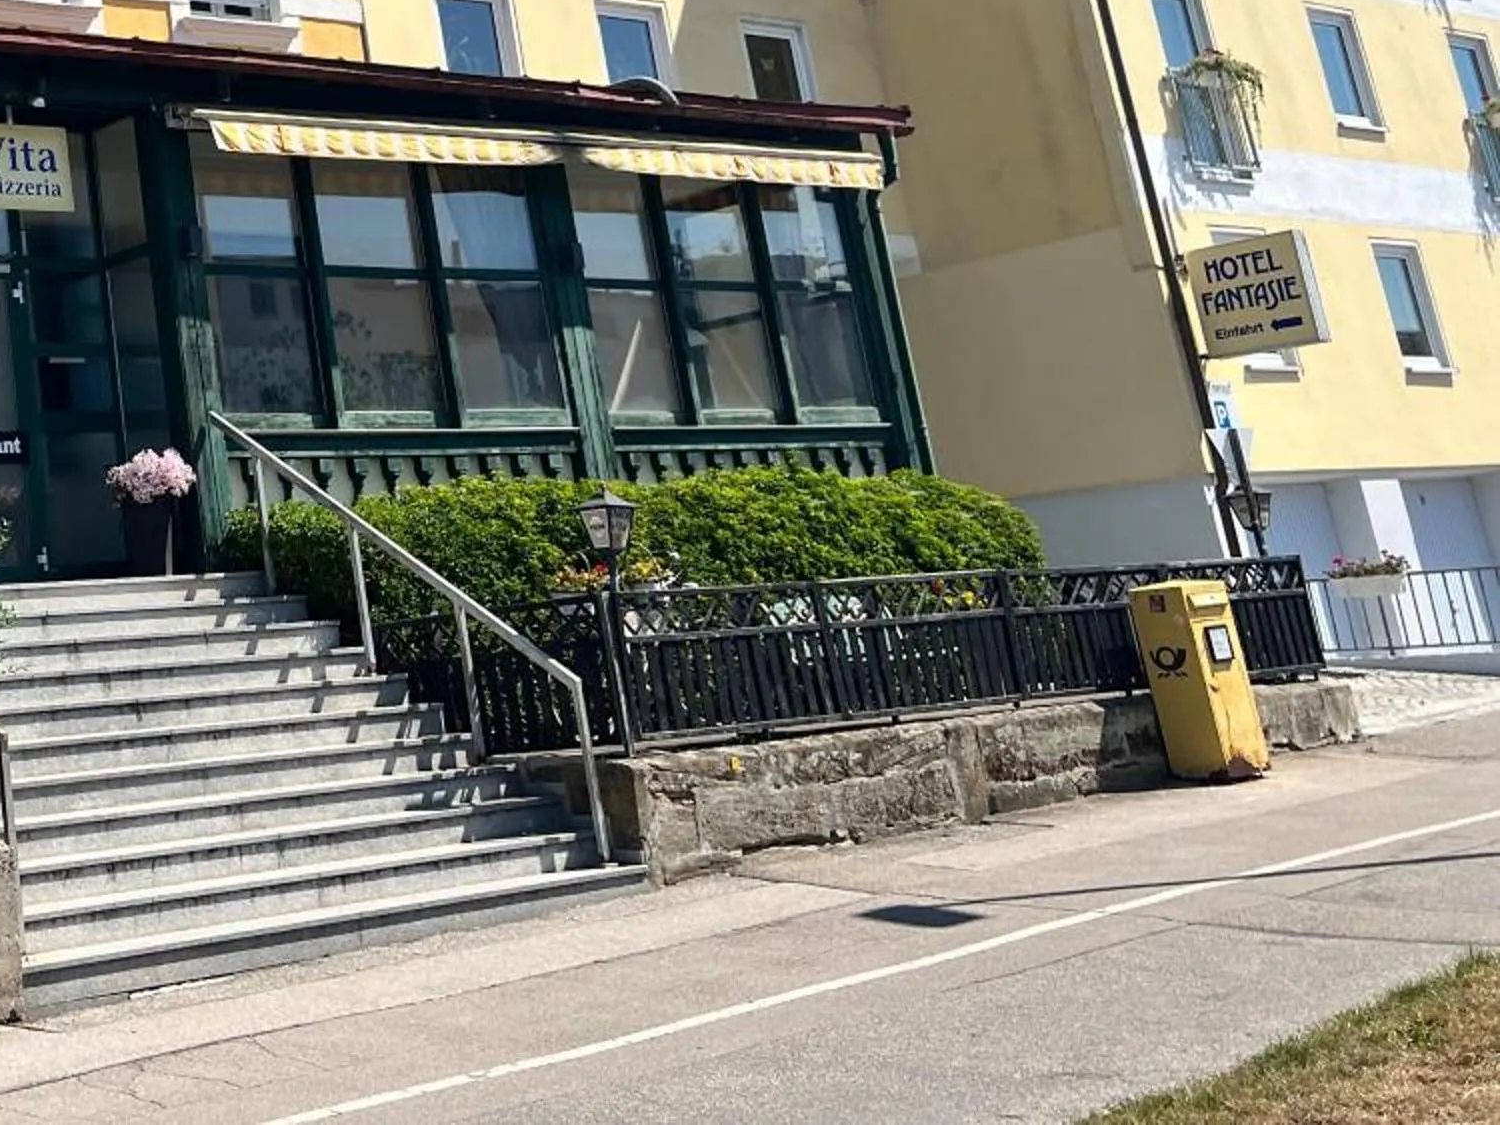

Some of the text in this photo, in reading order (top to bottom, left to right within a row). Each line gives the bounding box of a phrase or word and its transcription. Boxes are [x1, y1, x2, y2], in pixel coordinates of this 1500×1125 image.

[1203, 248, 1283, 284] HOTEL
[1201, 276, 1301, 316] FANTASIE
[1215, 322, 1265, 340] Einfahrt
